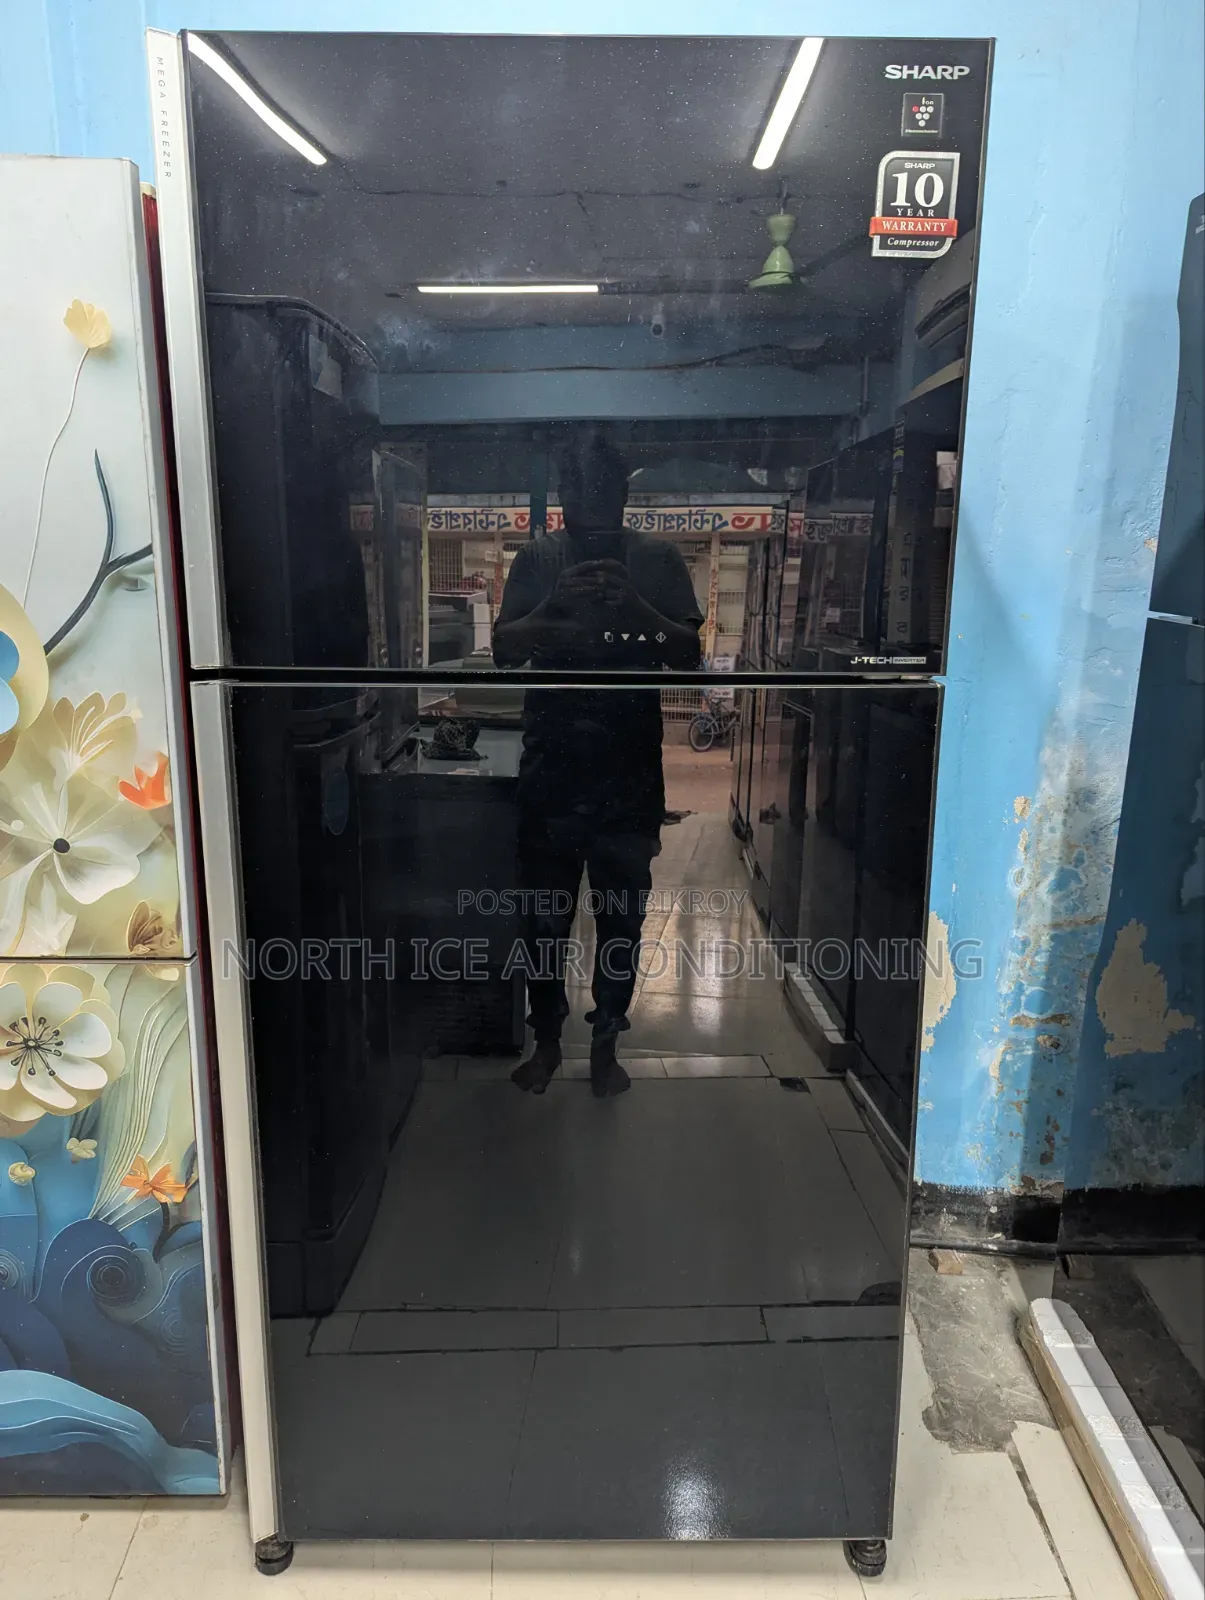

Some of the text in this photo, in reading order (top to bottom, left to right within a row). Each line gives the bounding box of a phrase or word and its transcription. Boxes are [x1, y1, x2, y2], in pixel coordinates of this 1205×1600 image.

[884, 64, 971, 80] SHARP
[156, 56, 172, 178] MEGA FREEZER
[890, 171, 944, 208] 10
[896, 208, 935, 217] YEAR
[882, 220, 947, 232] WARRANTY
[887, 237, 940, 248] Compressor
[850, 656, 893, 664] J-TECH
